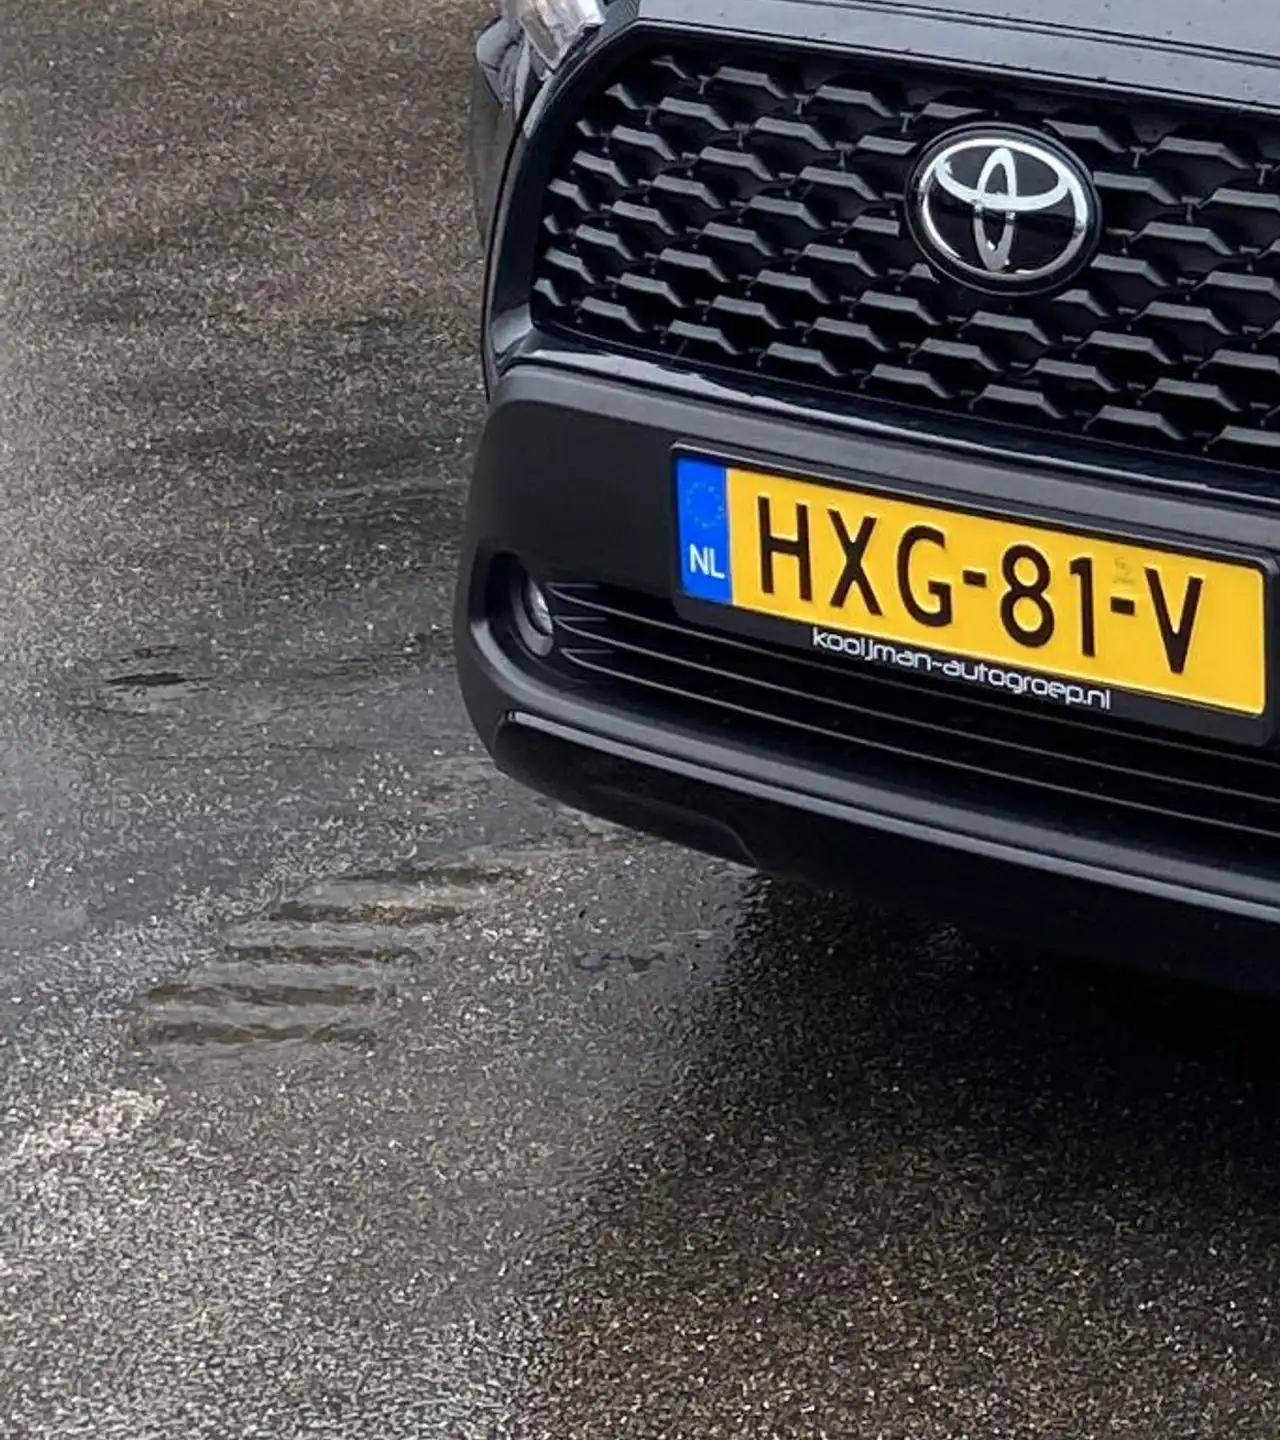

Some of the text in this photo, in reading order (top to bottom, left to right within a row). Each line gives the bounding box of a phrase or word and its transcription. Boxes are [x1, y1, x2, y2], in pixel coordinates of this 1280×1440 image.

[689, 543, 725, 579] NL
[757, 495, 1203, 675] HXG-81-V
[812, 626, 1111, 710] kooijman-autogroep.nl
